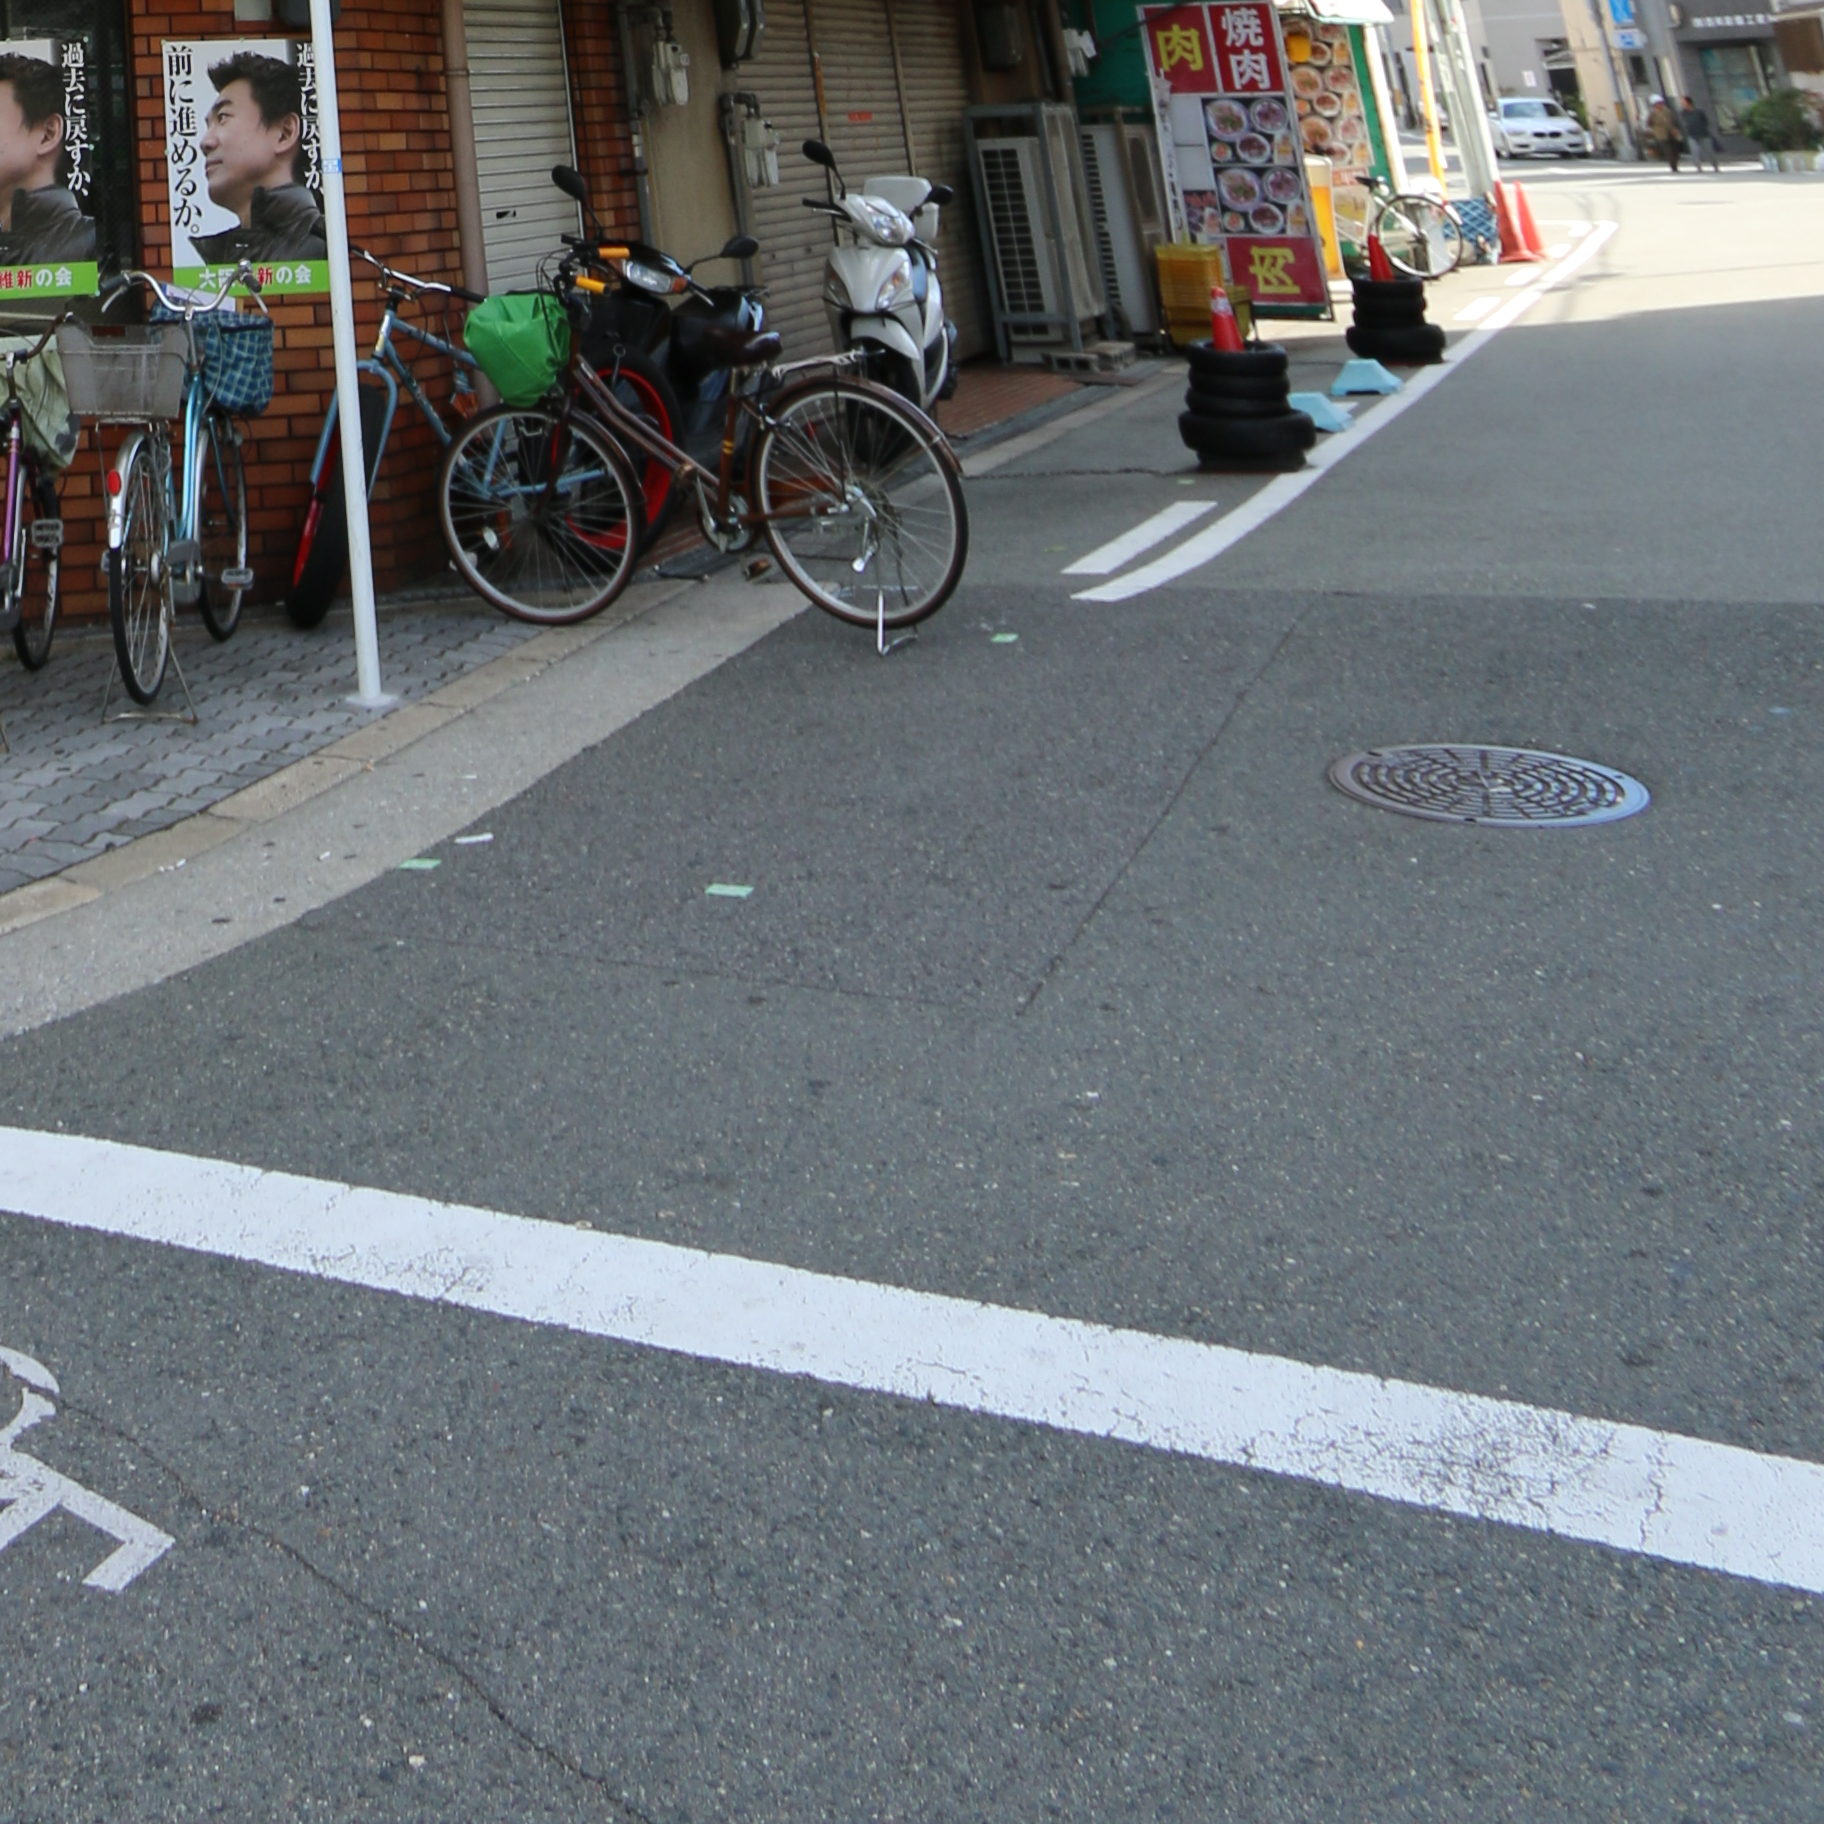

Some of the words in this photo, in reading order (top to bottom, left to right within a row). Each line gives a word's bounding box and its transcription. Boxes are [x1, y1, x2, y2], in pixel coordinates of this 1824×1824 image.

[1155, 23, 1205, 72] 肉
[1220, 7, 1272, 90] 焼肉
[166, 44, 203, 236] 前に進めるか。
[198, 263, 312, 289] 大阪新の会
